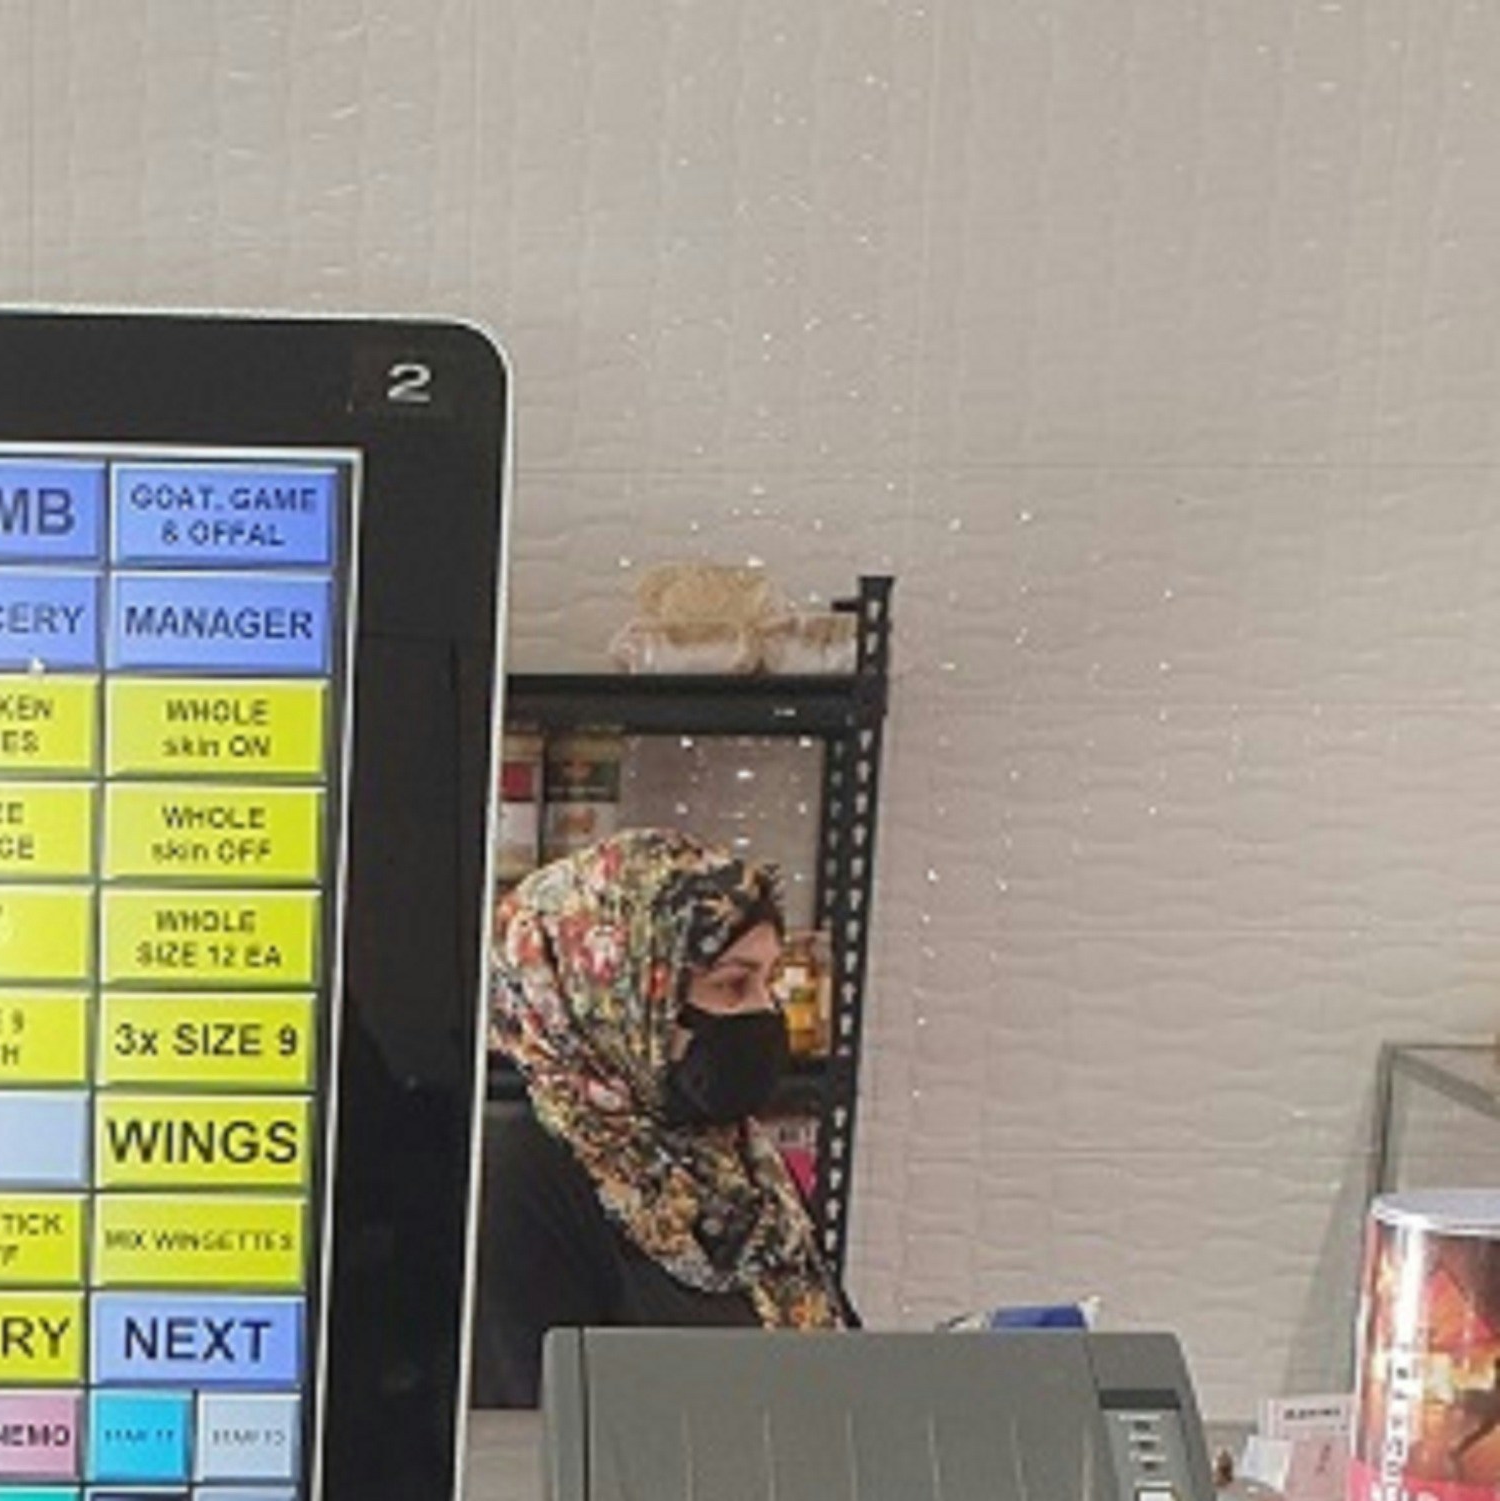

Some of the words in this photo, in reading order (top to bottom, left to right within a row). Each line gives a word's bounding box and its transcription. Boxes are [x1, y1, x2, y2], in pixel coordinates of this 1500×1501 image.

[387, 363, 432, 403] 2
[229, 486, 318, 513] GAME
[161, 520, 180, 545] &
[187, 521, 286, 547] OFFAL
[125, 606, 314, 640] MANAGER
[166, 699, 269, 726] WHOLE
[162, 735, 221, 759] skin
[227, 735, 272, 760] ON
[161, 806, 266, 831] WHOLE
[152, 840, 210, 864] skin
[217, 838, 272, 863] OFF
[155, 909, 258, 935] WHOLE
[135, 942, 197, 967] SIZE
[206, 944, 237, 968] 12
[243, 944, 282, 969] EA
[113, 1023, 159, 1057] 3x
[172, 1023, 264, 1057] SIZE
[277, 1026, 300, 1058] 9
[106, 1119, 300, 1165] WINGS
[123, 1317, 273, 1363] NEXT
